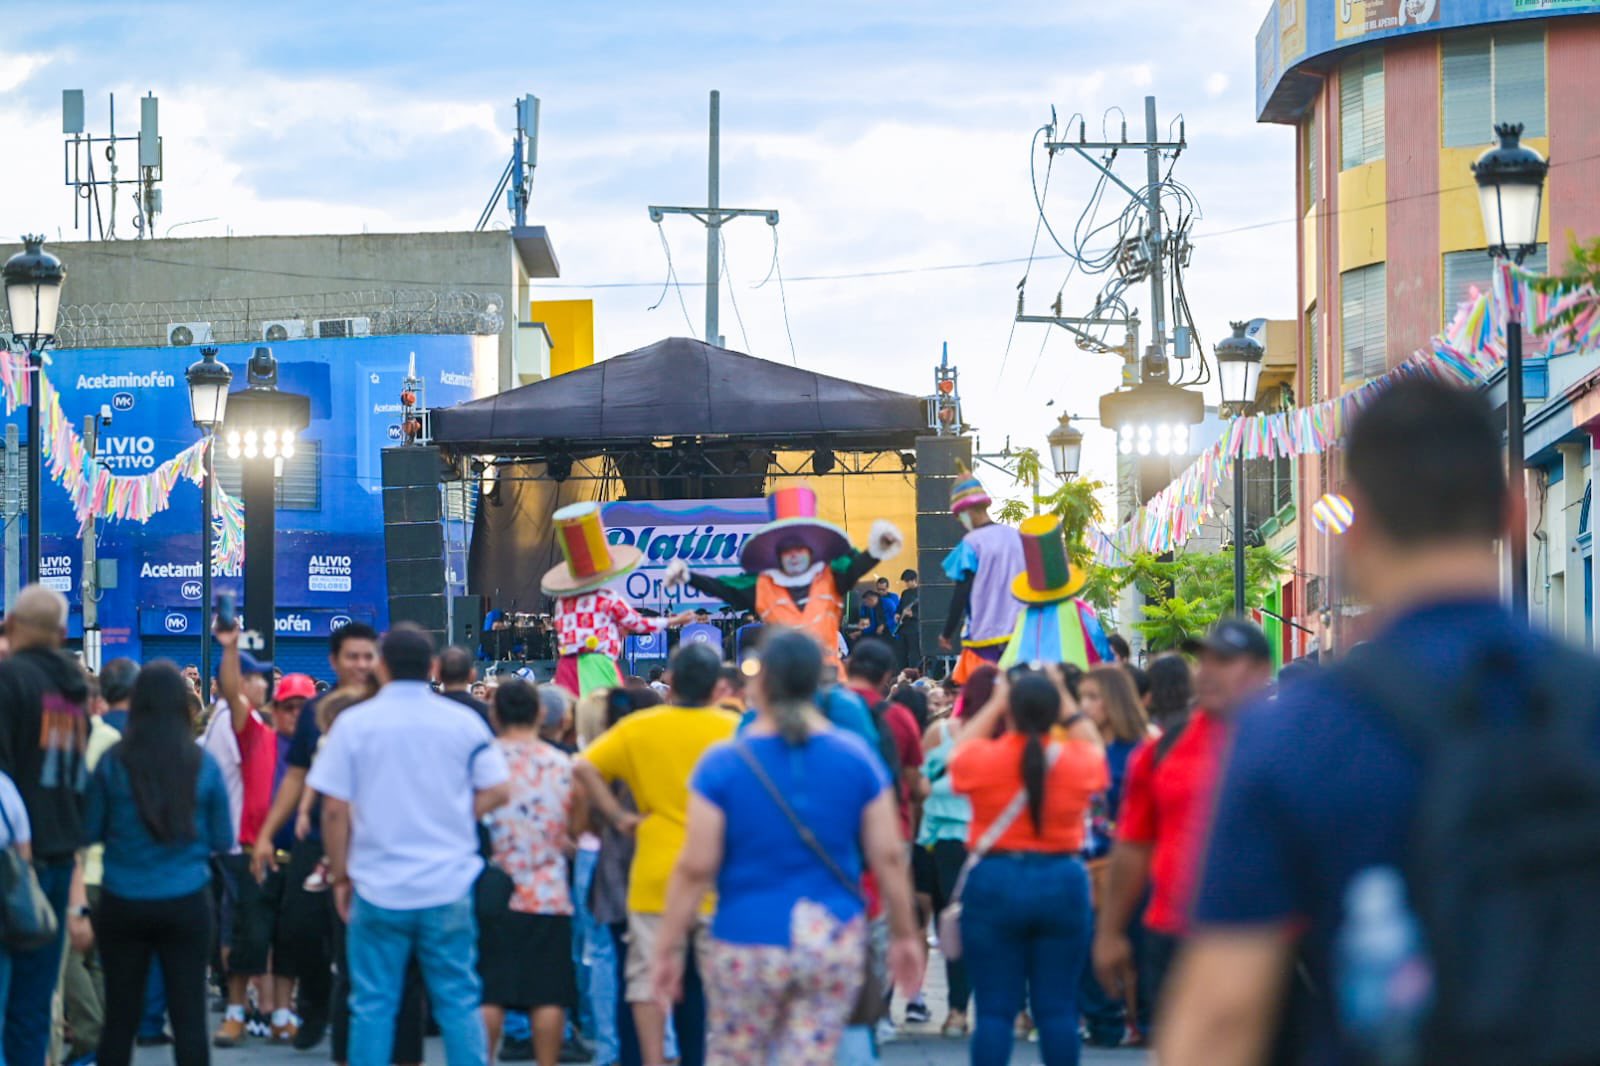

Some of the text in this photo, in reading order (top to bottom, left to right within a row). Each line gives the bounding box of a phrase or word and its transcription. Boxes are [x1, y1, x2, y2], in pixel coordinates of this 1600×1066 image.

[76, 371, 175, 390] Acetaminofén
[95, 436, 155, 454] LIVIO
[96, 455, 155, 468] ECTIVO
[309, 555, 351, 567] ALIVIO
[40, 568, 71, 576] FECTIVO
[309, 567, 351, 575] EFECTIVO
